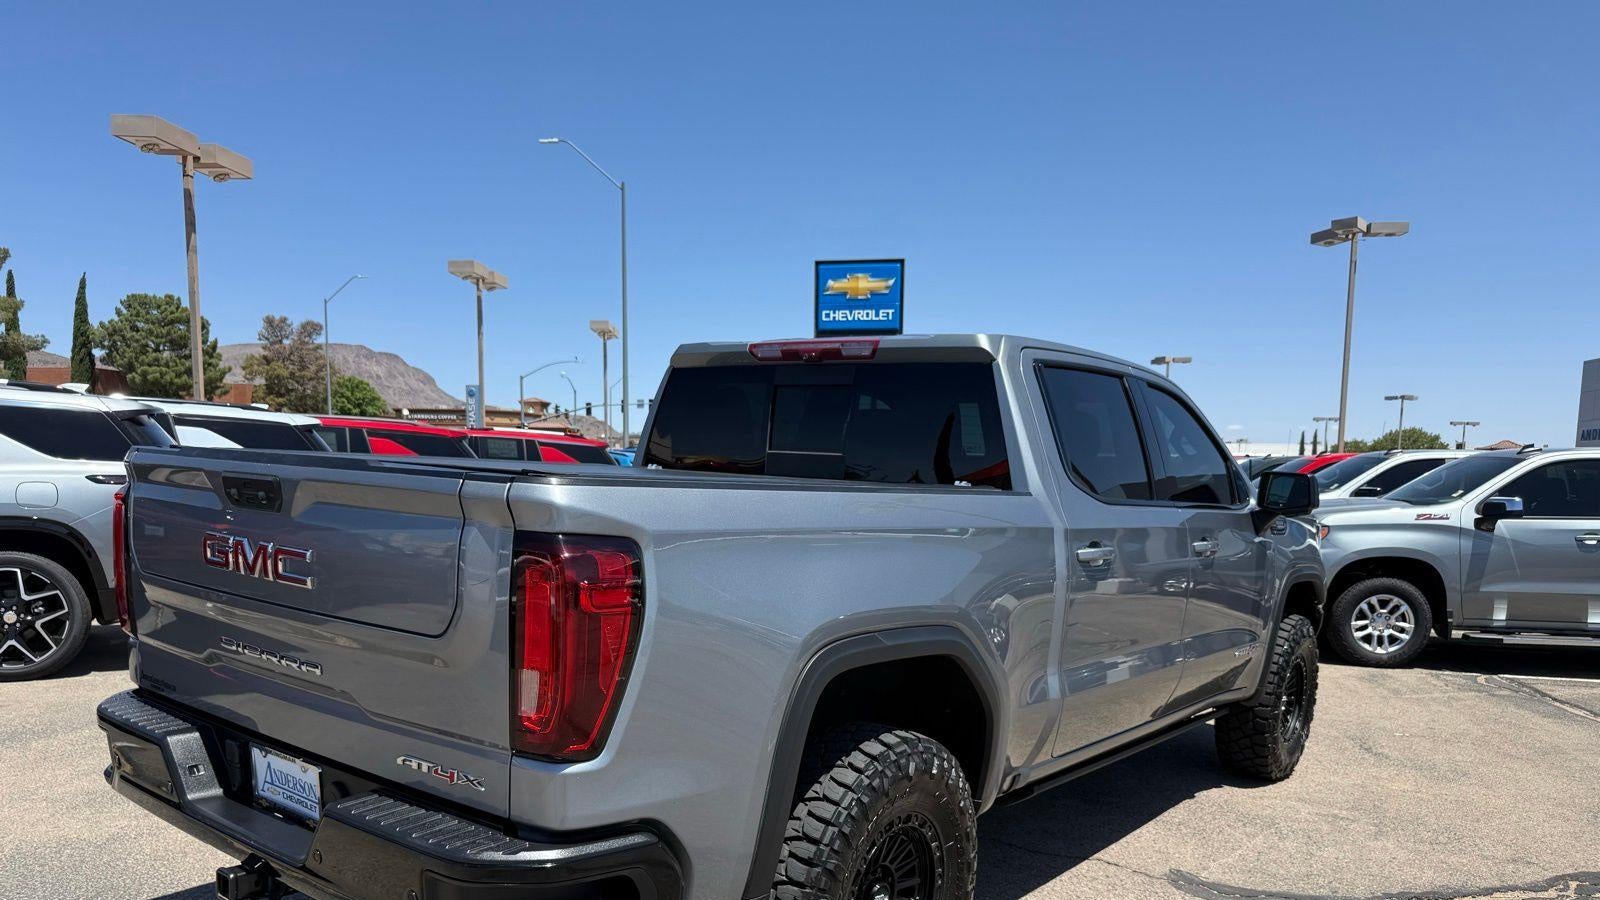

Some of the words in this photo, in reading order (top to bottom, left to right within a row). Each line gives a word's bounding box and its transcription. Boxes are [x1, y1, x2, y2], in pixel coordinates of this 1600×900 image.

[821, 309, 895, 321] CHEVROLET
[1580, 428, 1600, 441] AND
[202, 531, 314, 590] GMC
[220, 635, 323, 676] SIERRA
[261, 761, 318, 801] ANDERSON
[396, 754, 485, 791] AT4X
[282, 791, 317, 813] CHEVROLET
